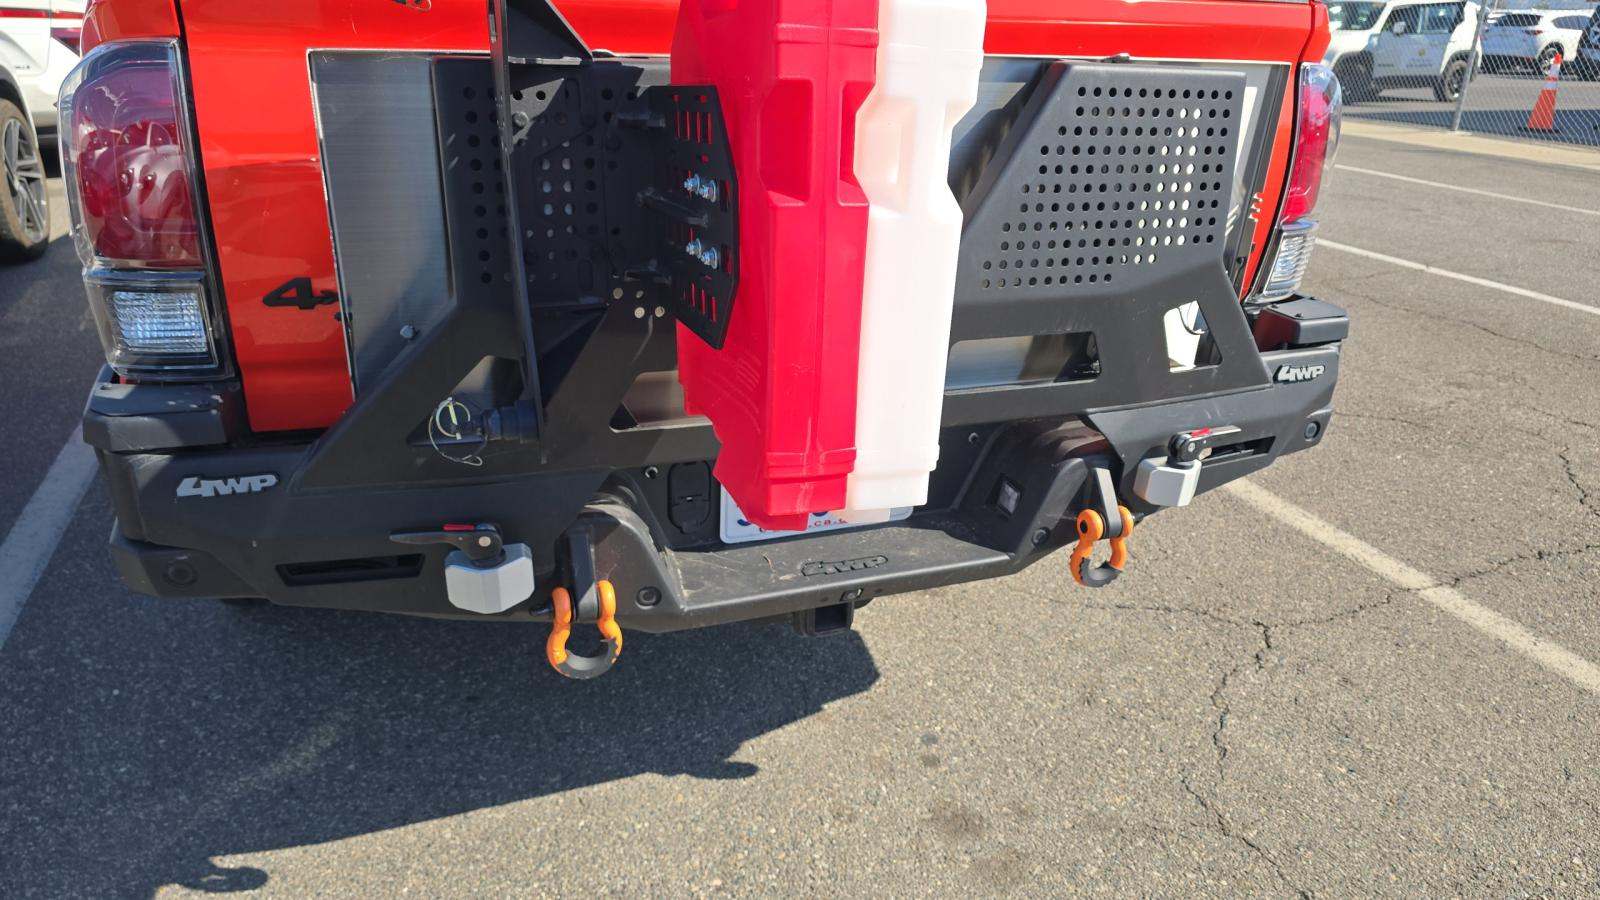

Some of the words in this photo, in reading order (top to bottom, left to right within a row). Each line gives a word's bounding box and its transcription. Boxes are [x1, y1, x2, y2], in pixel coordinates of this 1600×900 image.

[1277, 365, 1325, 382] 4WP
[176, 474, 278, 497] 4WP
[801, 555, 889, 577] 4WP
